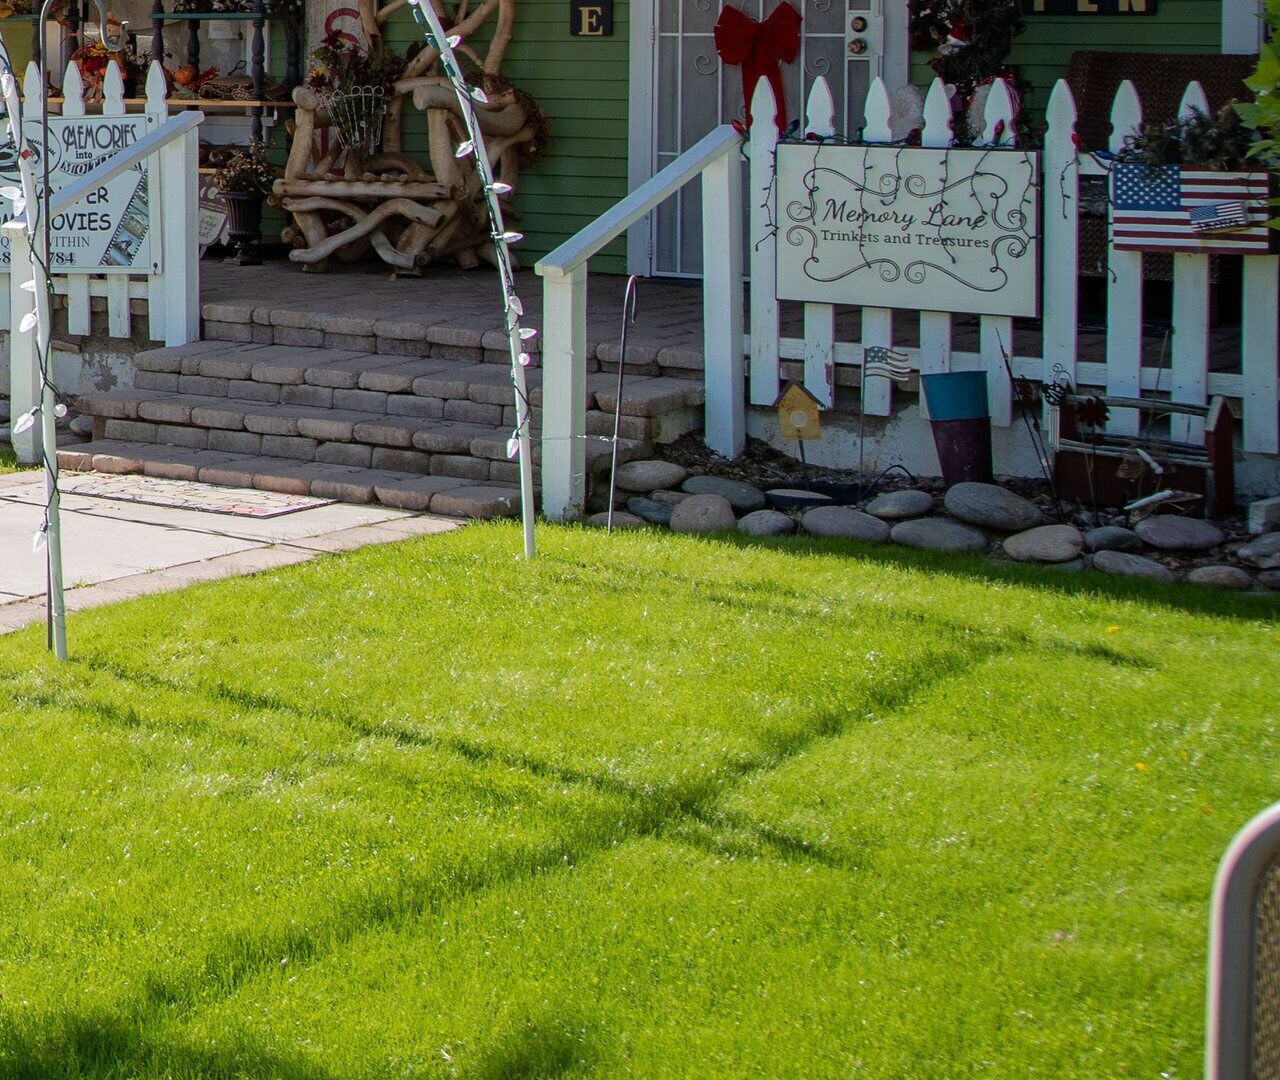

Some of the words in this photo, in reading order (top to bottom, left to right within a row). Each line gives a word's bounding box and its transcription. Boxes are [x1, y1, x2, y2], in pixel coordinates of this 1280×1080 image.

[75, 150, 93, 159] into
[49, 212, 112, 231] OVIES
[822, 198, 915, 231] Memory
[921, 202, 987, 230] Lane
[821, 229, 880, 244] Trinkets
[884, 233, 911, 245] and
[915, 234, 990, 249] Treasures
